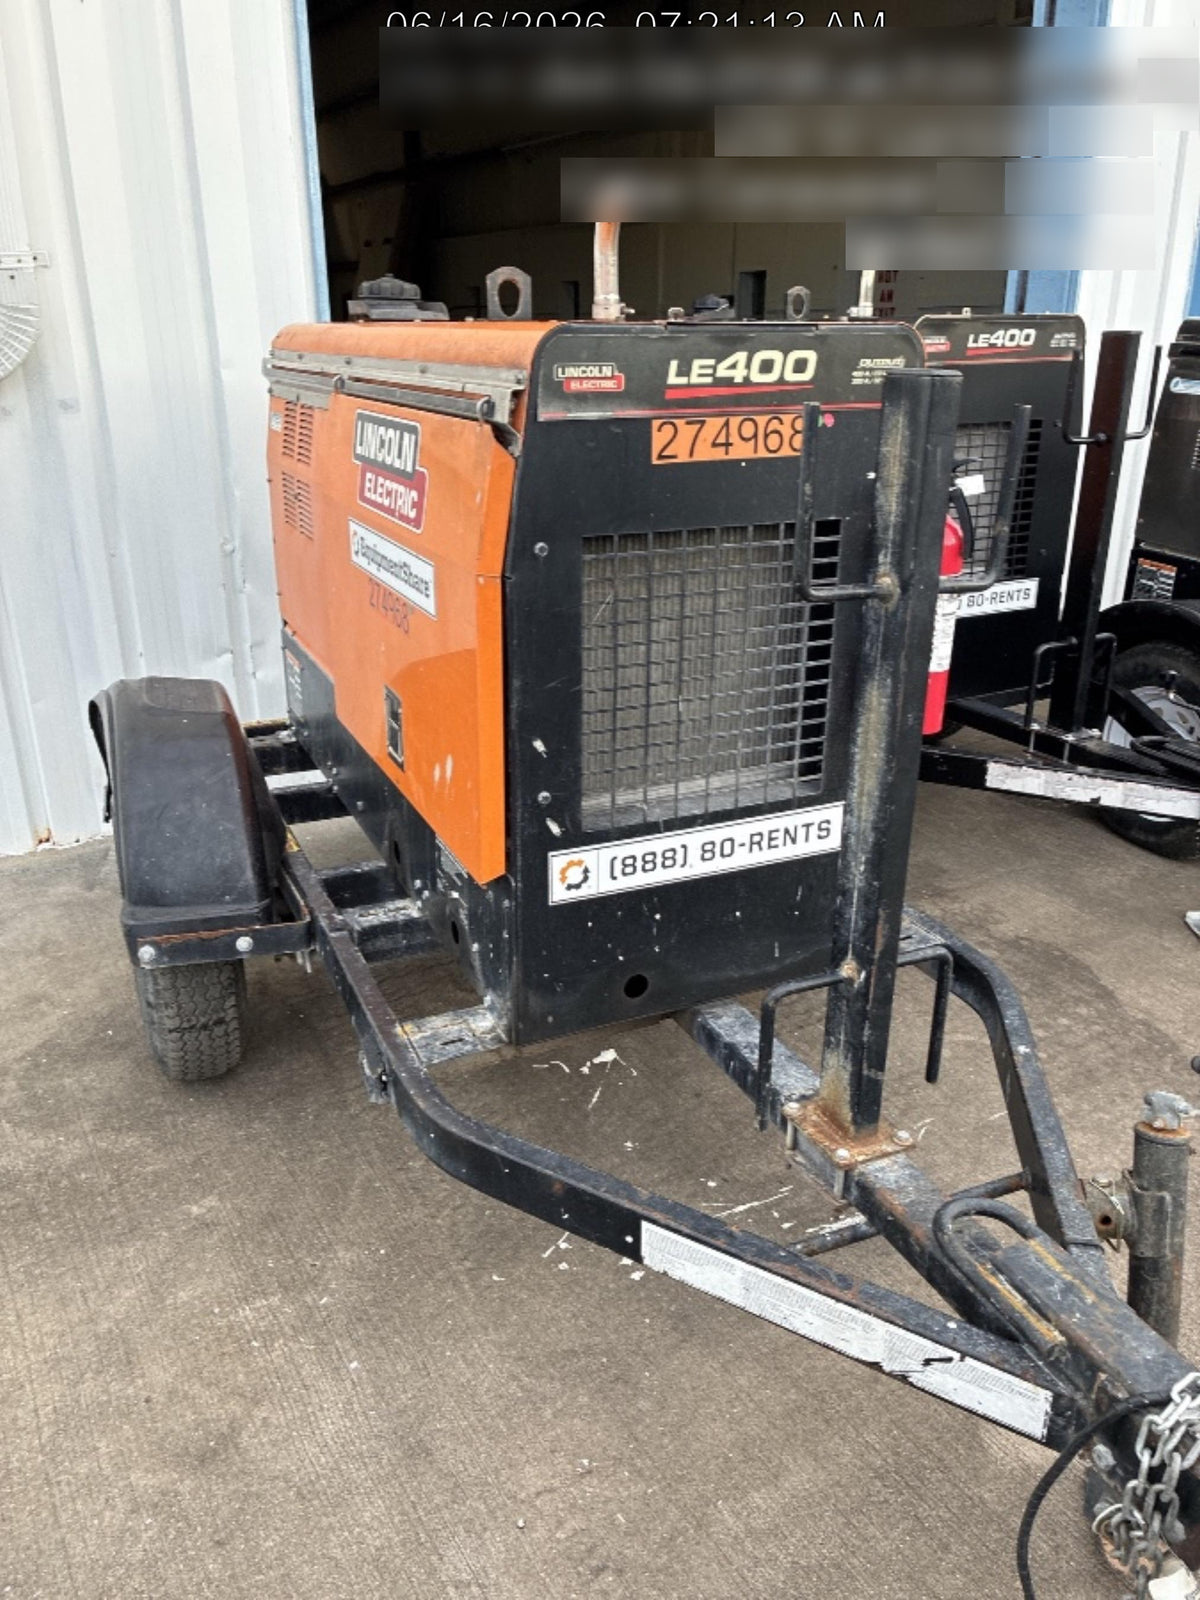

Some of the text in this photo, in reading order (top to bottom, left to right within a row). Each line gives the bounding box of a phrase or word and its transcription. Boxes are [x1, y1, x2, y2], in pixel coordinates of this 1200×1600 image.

[967, 328, 1036, 348] LE400
[557, 365, 612, 378] LINCOLN
[569, 379, 618, 390] ELECTRIC
[666, 349, 818, 385] LE400
[355, 420, 416, 473] LINCOLN
[656, 415, 804, 461] 274968
[363, 472, 419, 519] ELECTRIC
[360, 536, 430, 599] EquipmentShare
[967, 587, 1031, 608] 80-RENTS
[609, 819, 832, 881] (888) 80-RENTS
